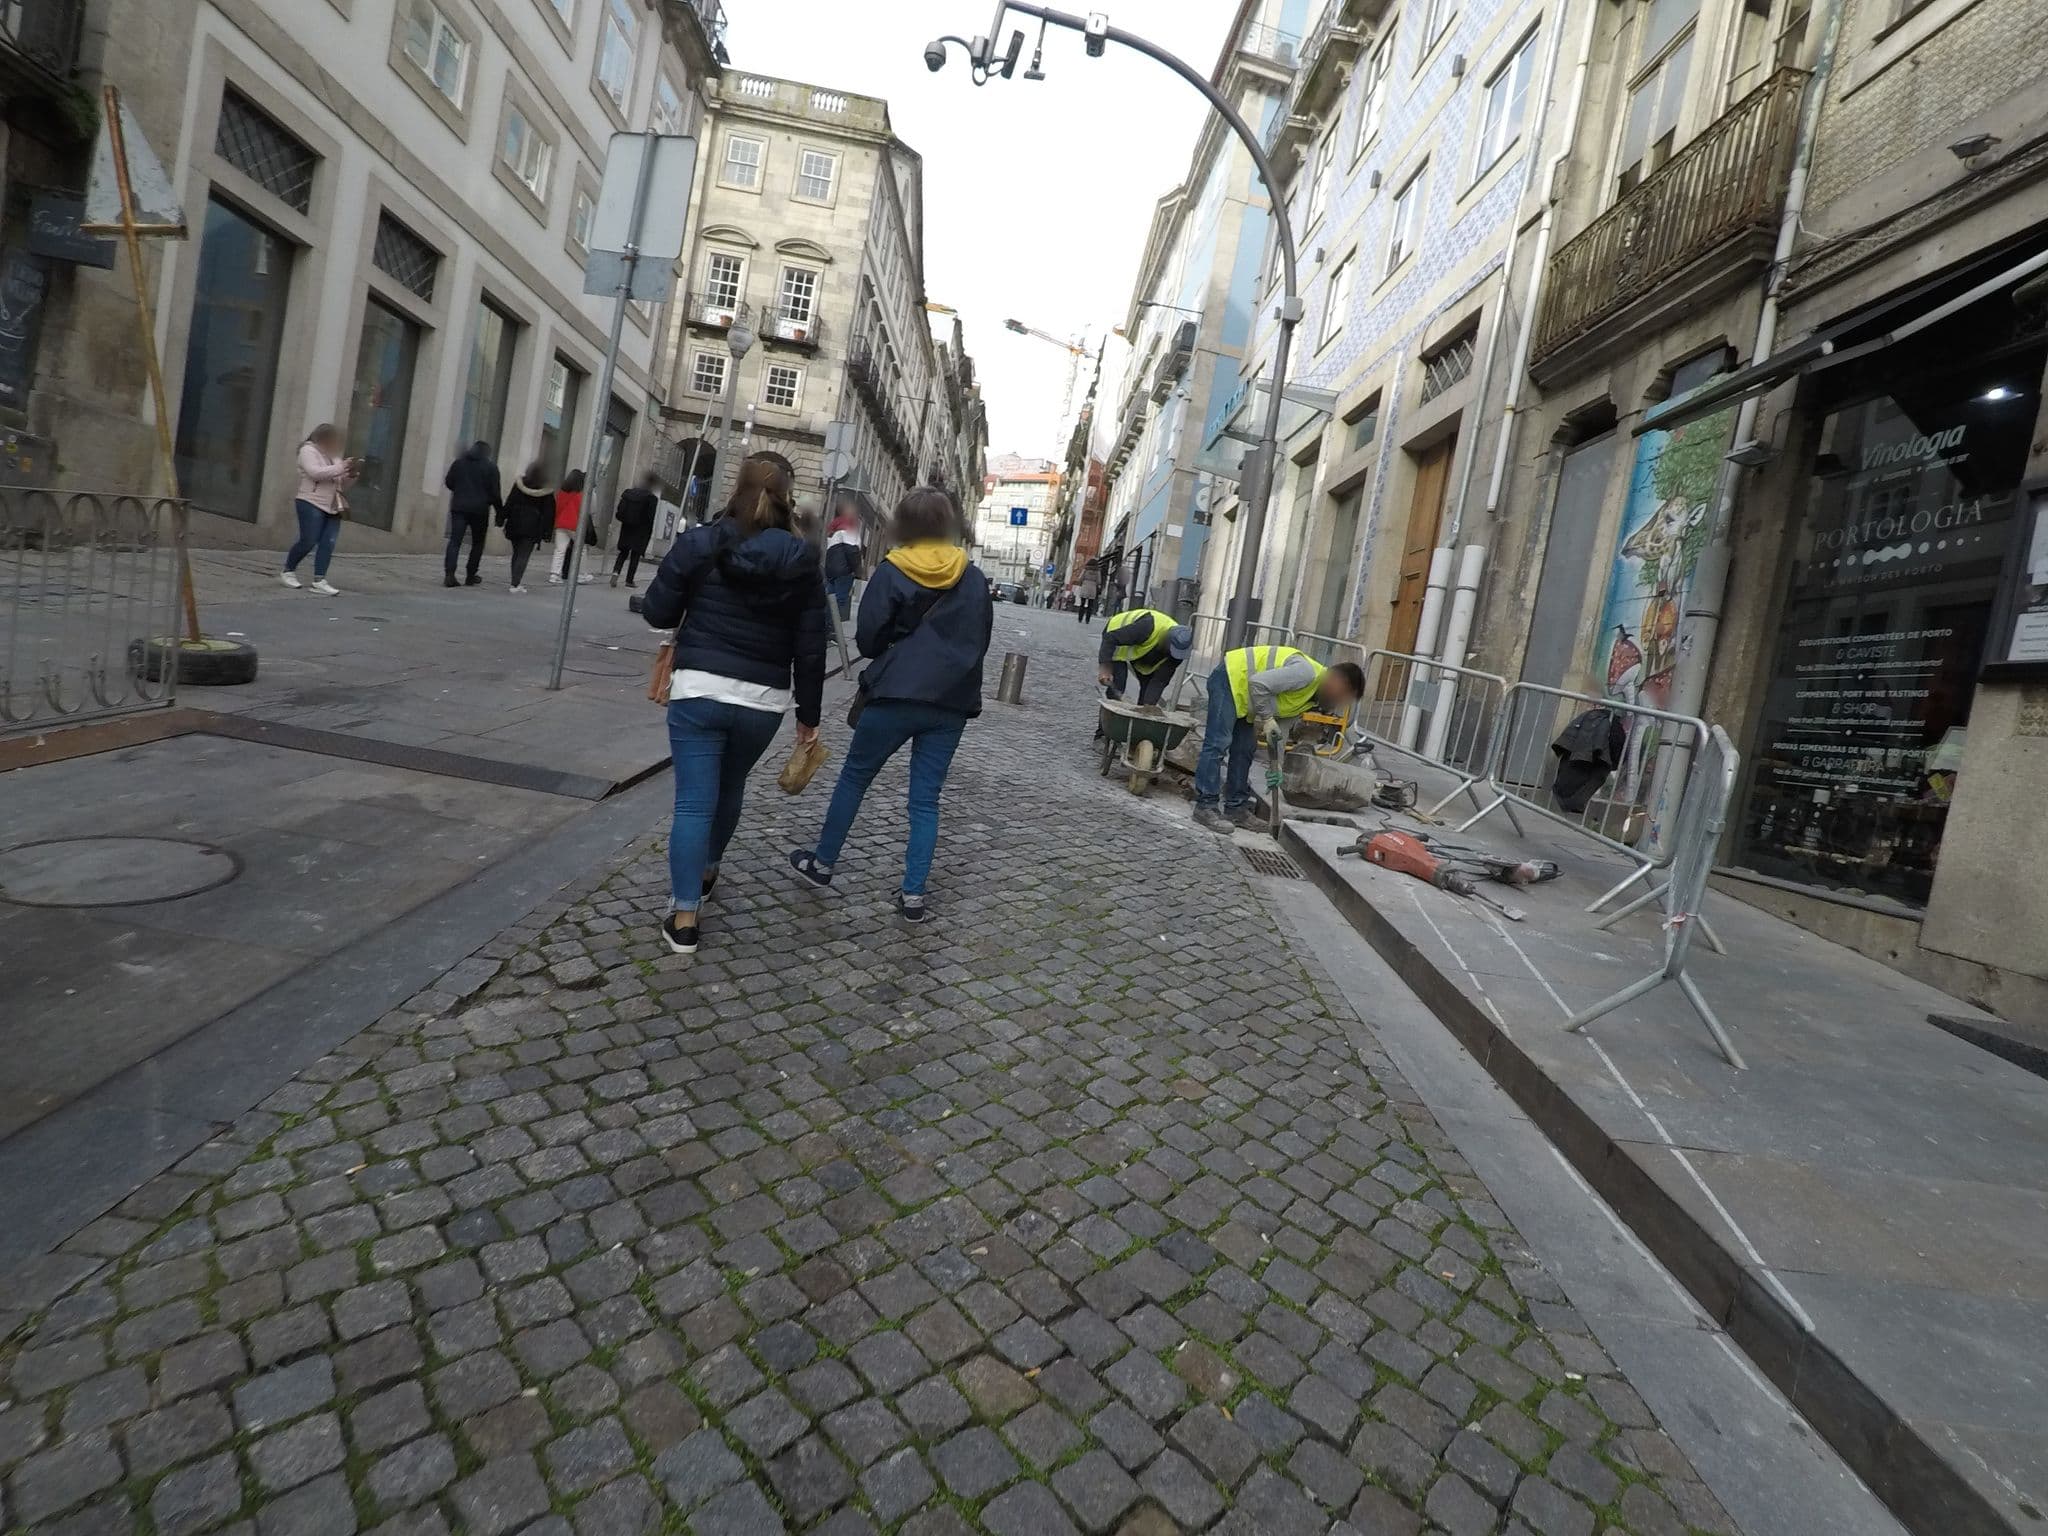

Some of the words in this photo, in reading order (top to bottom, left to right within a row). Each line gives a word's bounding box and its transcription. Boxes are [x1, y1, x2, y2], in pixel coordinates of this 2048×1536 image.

[1862, 425, 1967, 471] Vinologia
[1814, 500, 1982, 552] PORTOLOGIA
[1907, 630, 1920, 640] DE
[1921, 628, 1953, 639] PORTO
[1847, 645, 1897, 659] CAVISTE
[1842, 690, 1864, 698] PORT
[1865, 690, 1886, 698] WINE
[1888, 689, 1929, 698] TASTINGS
[1843, 703, 1877, 715] SHOP
[1772, 742, 1798, 751] PROVAS
[1799, 743, 1847, 753] COMENTADAS
[1848, 746, 1859, 754] DE
[1860, 747, 1885, 756] VINHO
[1901, 749, 1932, 759] PORTO
